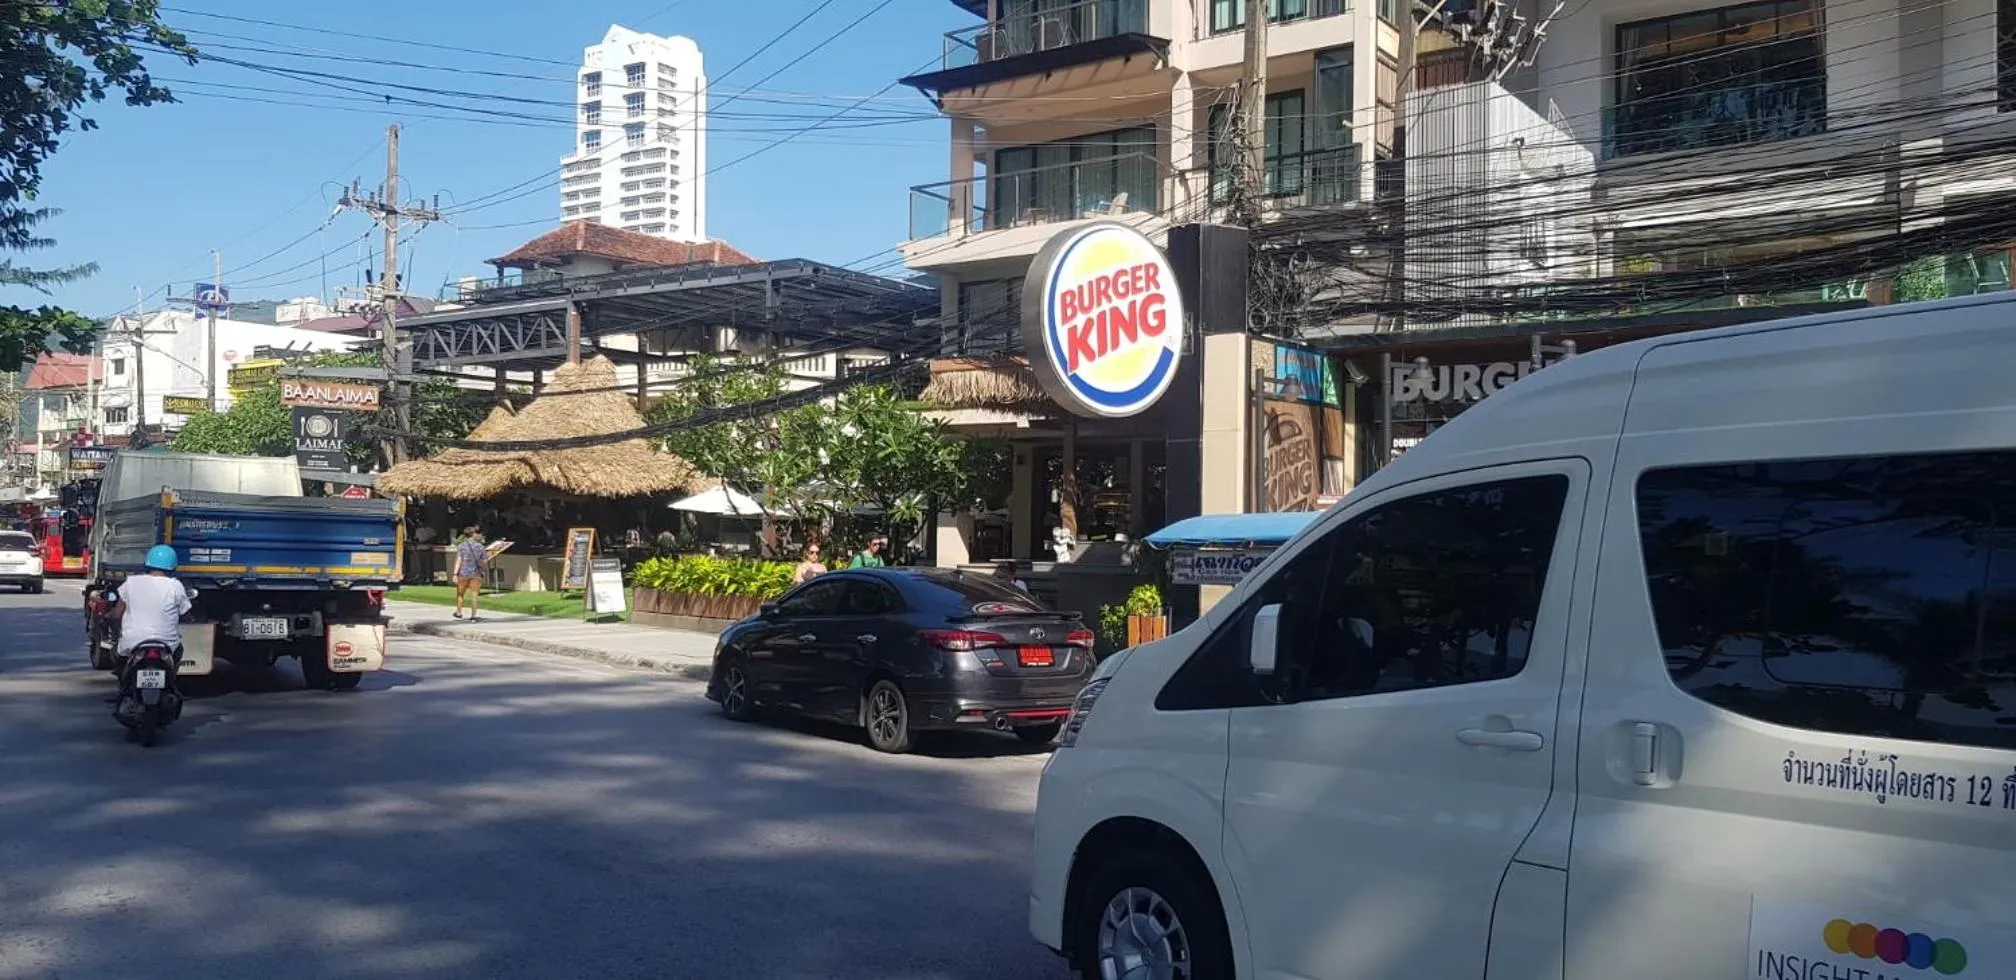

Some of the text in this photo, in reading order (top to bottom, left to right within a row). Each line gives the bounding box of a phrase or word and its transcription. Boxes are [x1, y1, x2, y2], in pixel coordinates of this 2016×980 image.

[1060, 262, 1161, 326] BURGER
[1067, 293, 1166, 372] KING
[284, 384, 378, 404] BAANLAIMAI
[1393, 359, 1554, 400] BURG
[72, 449, 113, 460] WATTAN
[295, 438, 342, 449] LAIMAI
[1264, 439, 1312, 482] BURGER
[1265, 460, 1313, 511] KING
[1783, 749, 1957, 804] จำนวนที่นั่งผู้โดยสาร
[1966, 774, 1992, 806] 12
